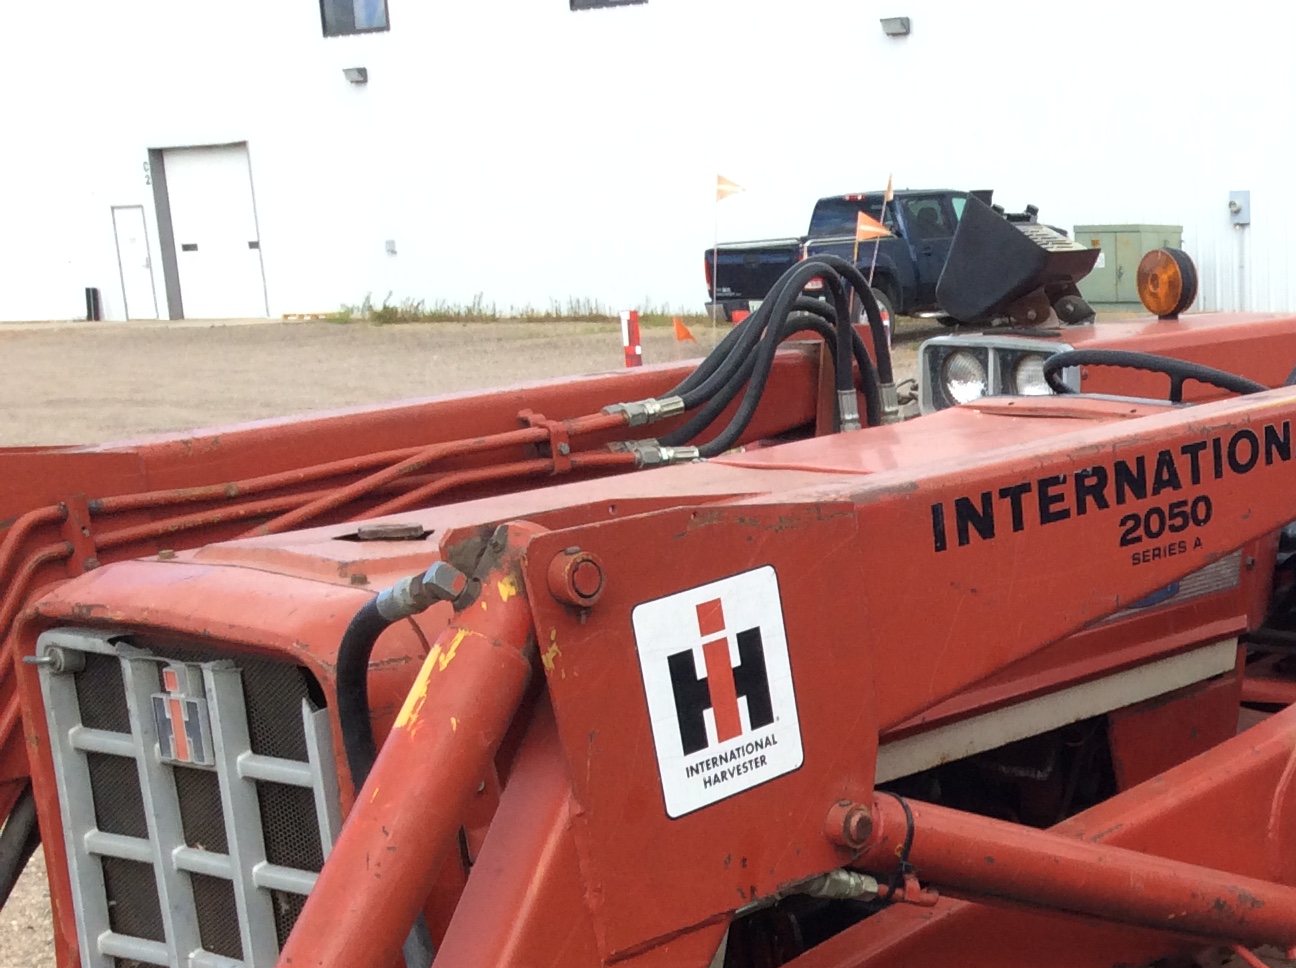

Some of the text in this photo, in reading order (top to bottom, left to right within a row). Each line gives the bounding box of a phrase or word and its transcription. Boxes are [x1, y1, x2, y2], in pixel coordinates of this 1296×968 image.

[1119, 495, 1212, 547] 2050
[1132, 537, 1203, 566] SERIES A
[686, 734, 778, 778] INTERNATIONAL
[703, 755, 767, 789] HARVESTER
